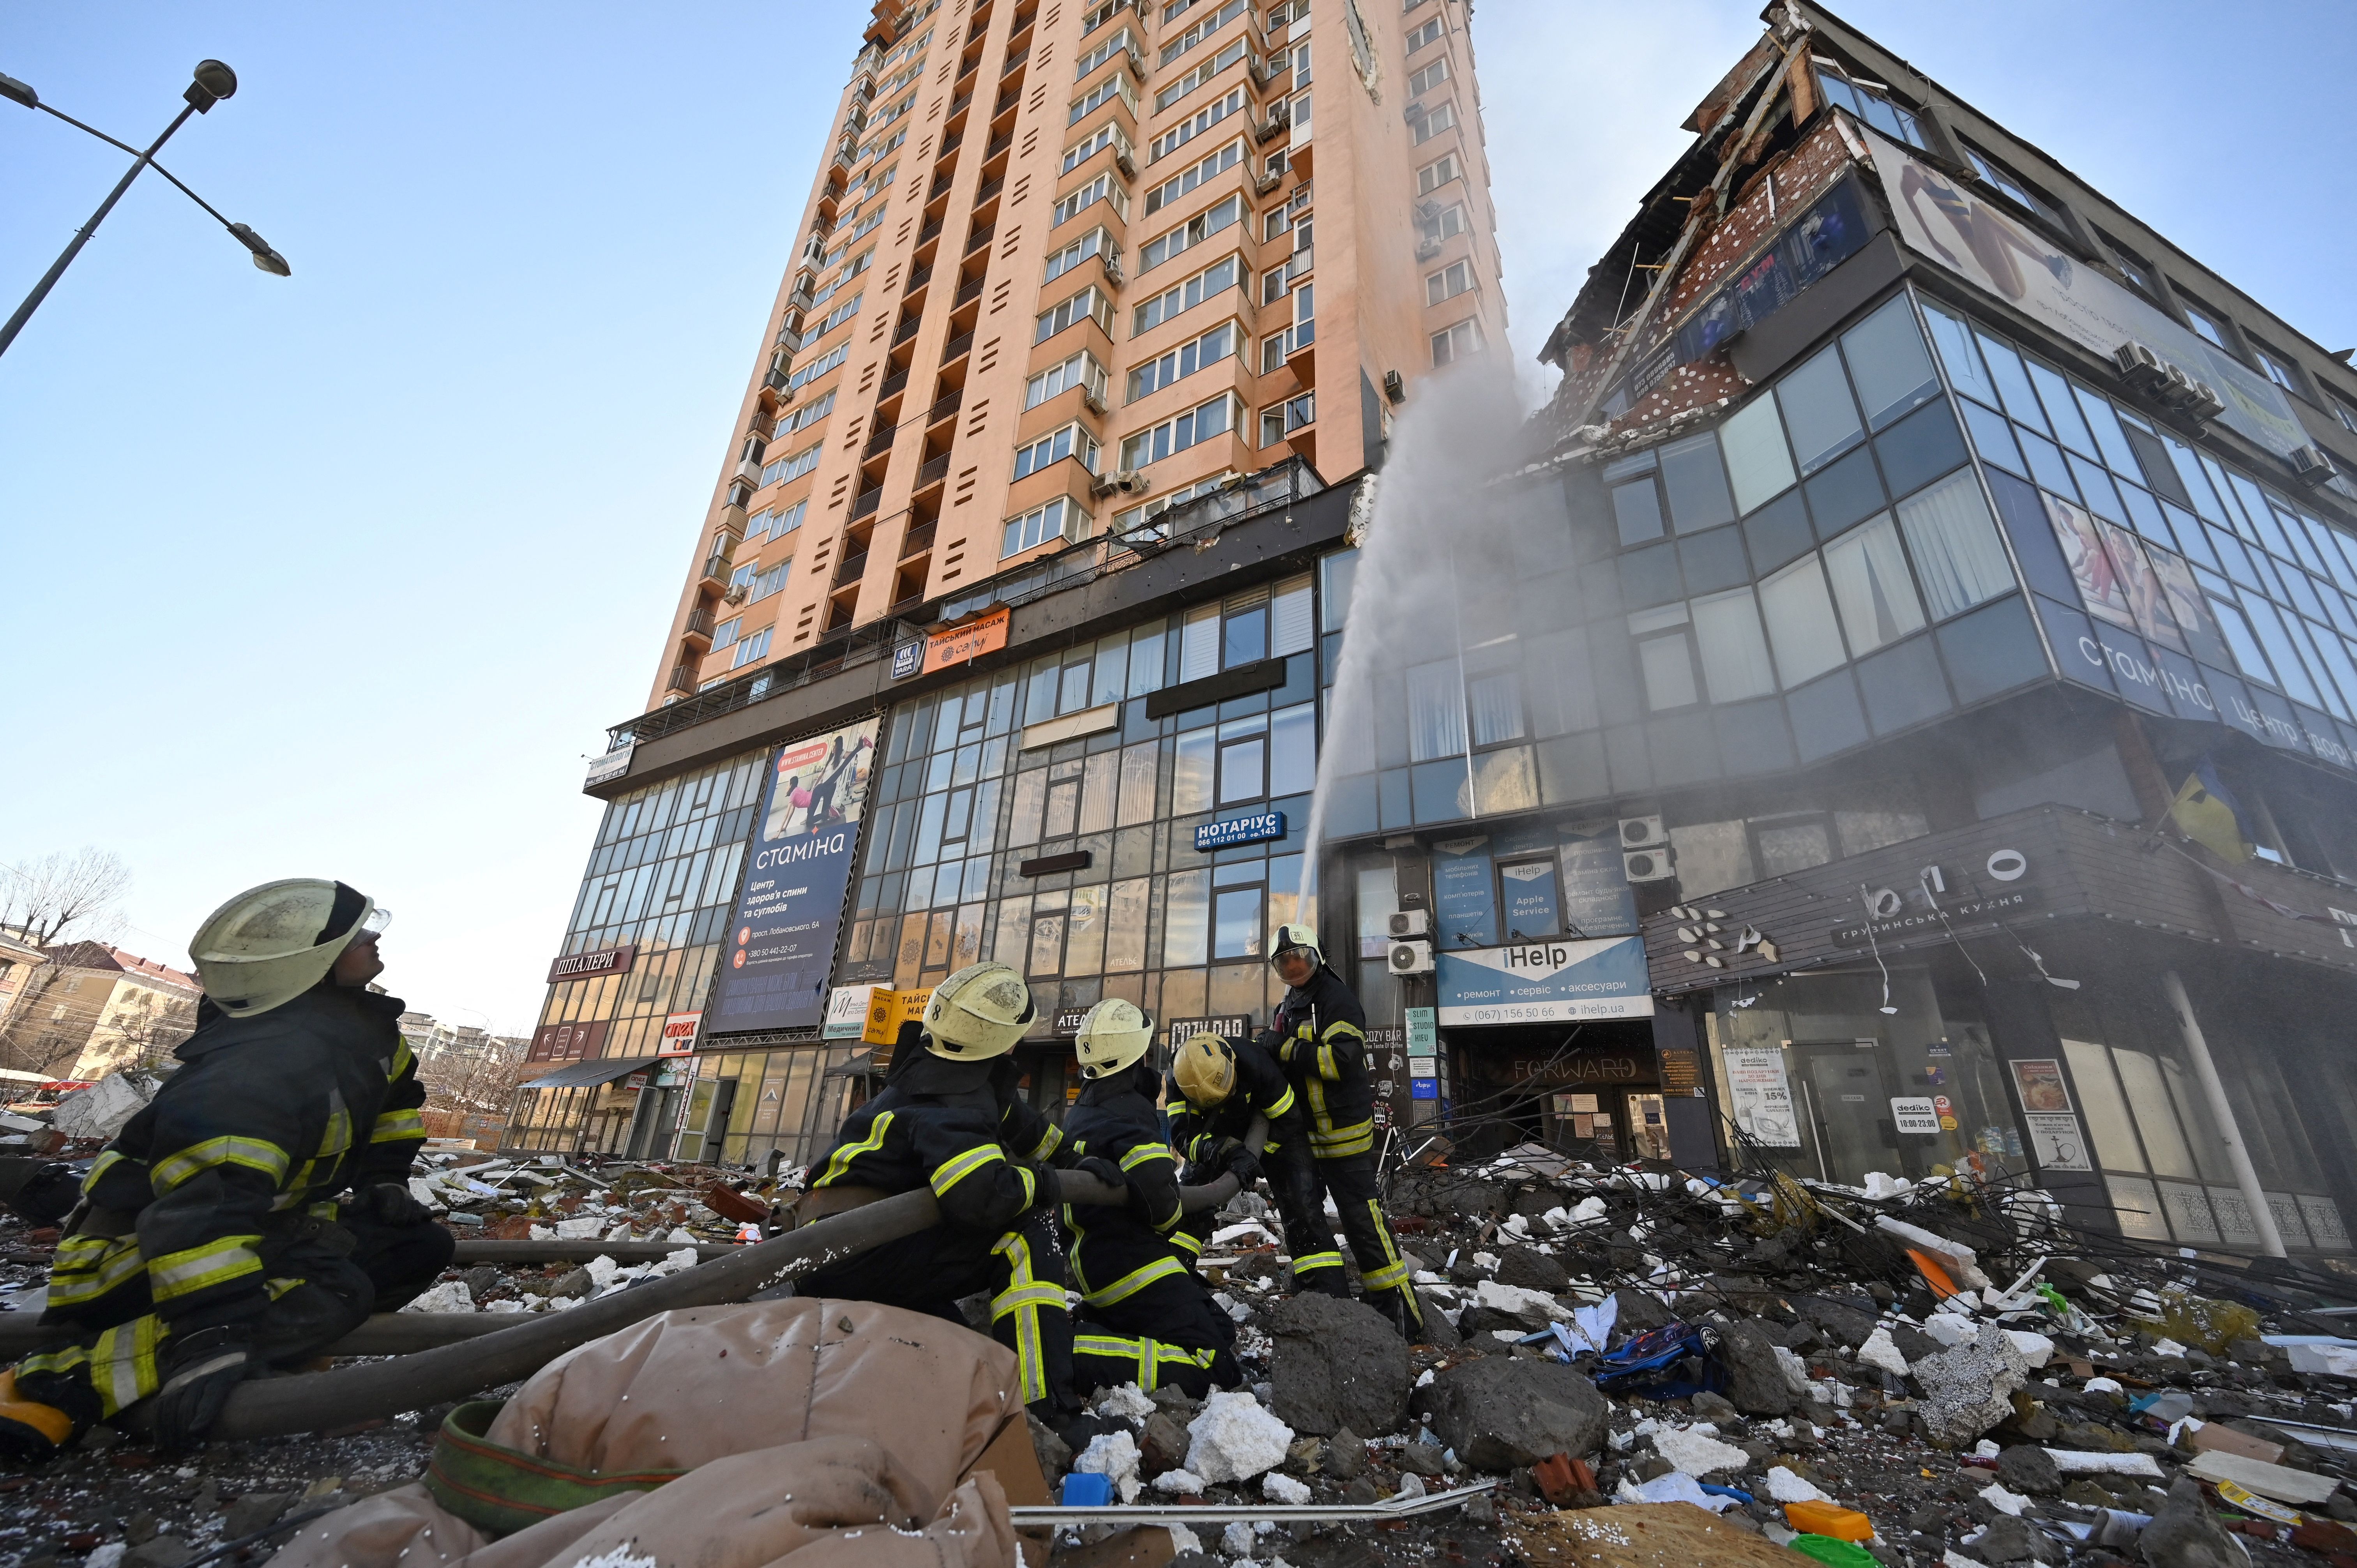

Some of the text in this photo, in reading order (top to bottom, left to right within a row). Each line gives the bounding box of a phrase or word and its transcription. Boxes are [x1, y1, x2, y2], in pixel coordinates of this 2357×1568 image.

[1740, 254, 1774, 290] GYM
[1634, 351, 1675, 391] 073 0896885
[1637, 387, 1649, 399] 098
[930, 616, 1005, 649] ТАЙСЬКИЙ МАСАЖ
[895, 664, 912, 675] YARA
[591, 749, 631, 770] СТОМАТОЛОГІЯ
[781, 748, 823, 767] WWW.STAMINA.CENTER
[665, 779, 677, 790] 20
[1198, 814, 1276, 838] НОТАРІУС
[1572, 820, 1605, 830] РЕМОНТ
[1445, 840, 1475, 849] РЕМОНТ
[1574, 846, 1611, 857] прошивка
[1445, 864, 1479, 873] мобільних
[1515, 866, 1540, 876] iHelp
[1445, 871, 1478, 879] телефонів
[750, 879, 774, 892] Центр
[747, 886, 807, 905] здоров'я спини
[1444, 890, 1484, 899] комп'ютерів
[1567, 885, 1629, 899] ремонт будь-якої
[1516, 895, 1544, 906] Apple
[1578, 894, 1619, 904] складності
[754, 902, 787, 918] суглобів
[1449, 911, 1483, 919] планшетів
[1512, 907, 1549, 916] Service
[1581, 915, 1622, 925] програмне
[1843, 895, 2023, 939] ГРУЗИНСЬКА КУХНЯ
[752, 930, 768, 939] просп.
[769, 923, 810, 936] Лобановського,
[748, 944, 797, 957] +380 50 441-22-07
[1503, 944, 1566, 969] iHelp
[555, 952, 616, 975] ШПАЛЕРИ
[1110, 957, 1137, 966] АТЕЛЬЄ
[726, 972, 797, 996] САМОЛІКУВАННЯ МОЖЕ БУТИ
[1464, 981, 1626, 1000] ремонт сервіс аксесуари
[752, 994, 766, 1015] ДЛЯ
[764, 992, 788, 1012] ВАШОГО
[1581, 1004, 1624, 1015] ihelp.ua
[932, 1004, 941, 1021] 8
[1413, 1010, 1428, 1018] SLIM
[1475, 1006, 1554, 1021] (067) 156 50 66
[664, 1021, 696, 1038] anex
[828, 1024, 860, 1033] Медичний
[1413, 1021, 1434, 1030] STUDIO
[1386, 1030, 1401, 1041] BAR
[1415, 1034, 1428, 1042] KIEV
[673, 1038, 693, 1051] tour
[1083, 1042, 1090, 1054] 8
[1514, 1058, 1636, 1079] FORWARD
[631, 1074, 645, 1082] anex
